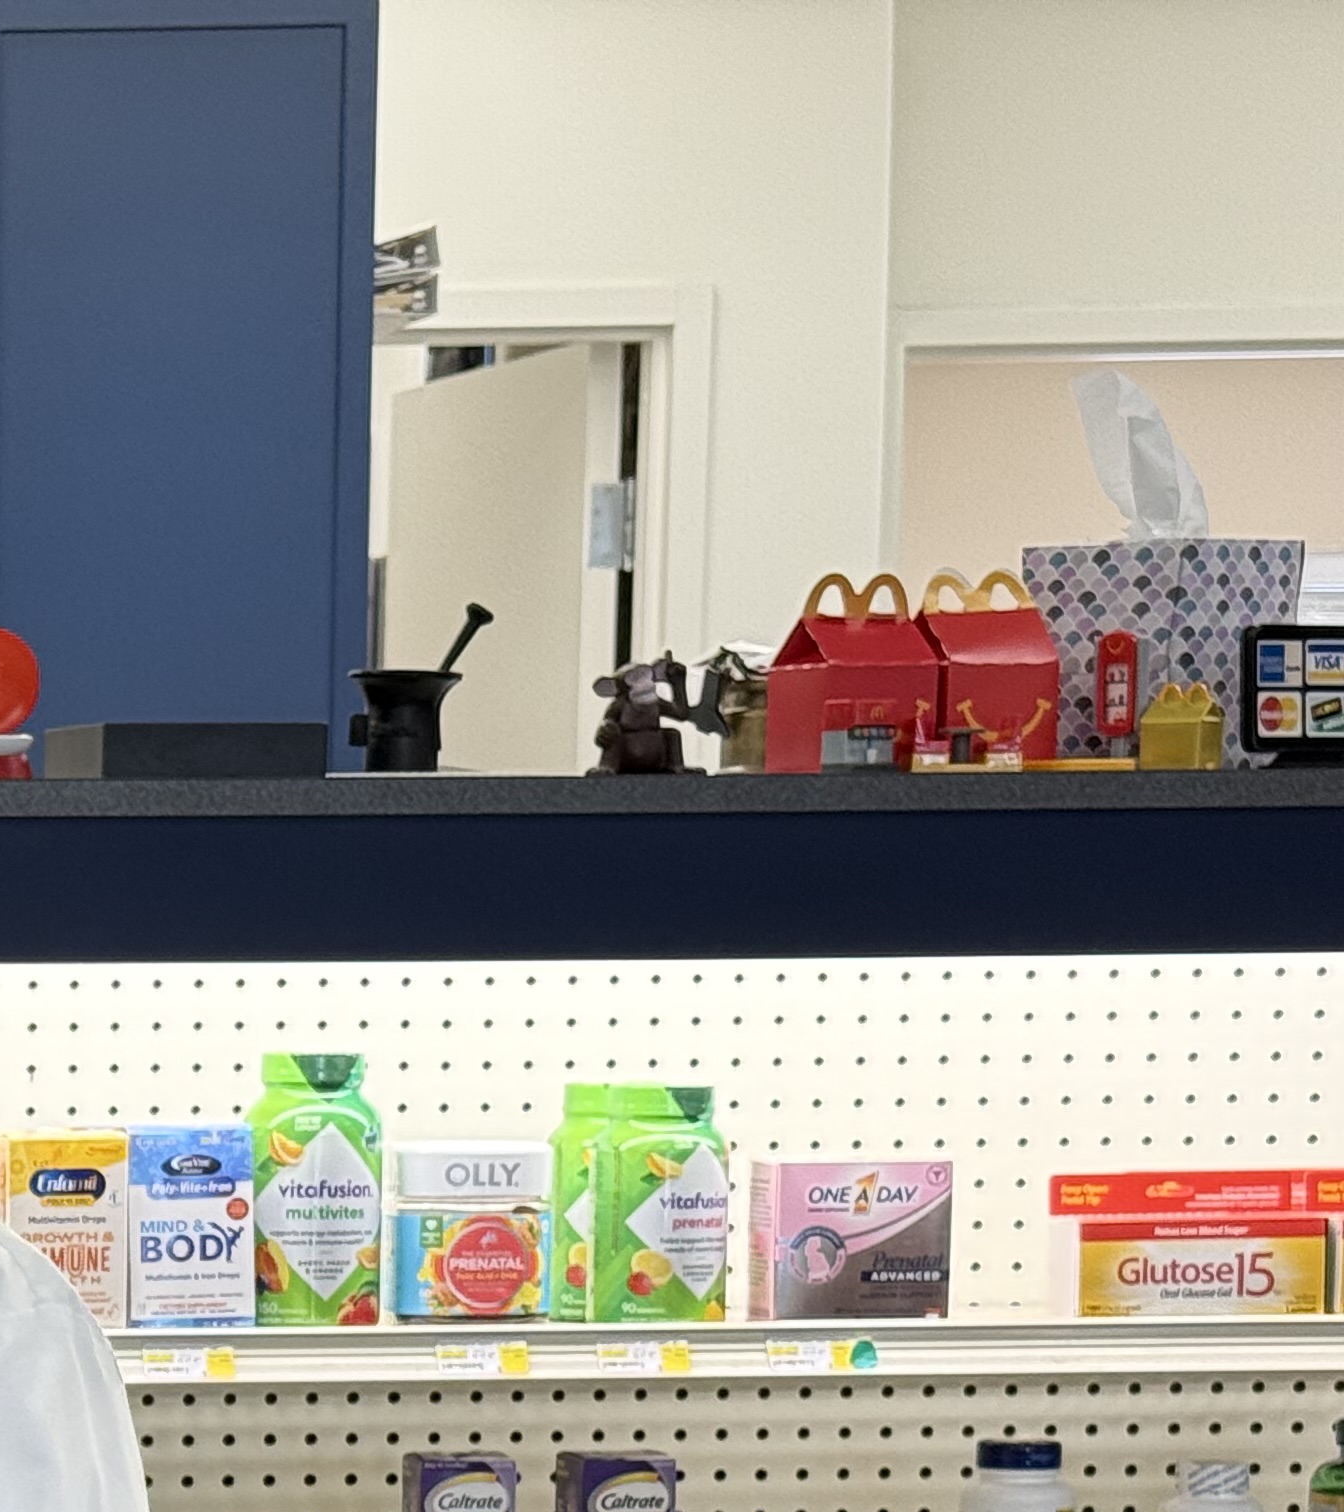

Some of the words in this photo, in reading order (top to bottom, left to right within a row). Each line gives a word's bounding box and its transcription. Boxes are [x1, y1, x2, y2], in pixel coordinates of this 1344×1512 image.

[278, 1179, 373, 1198] vitafusion
[808, 1185, 849, 1204] ONE
[875, 1185, 918, 1203] DAY
[285, 1204, 364, 1221] multivites
[140, 1220, 188, 1233] MIND
[193, 1218, 205, 1232] &
[671, 1214, 723, 1234] prenatal
[450, 1257, 525, 1270] PRENATAL
[872, 1252, 945, 1269] Prenatal
[870, 1271, 941, 1283] ADVANCED
[438, 1492, 504, 1511] Caltrate
[600, 1492, 665, 1511] Caltrate
